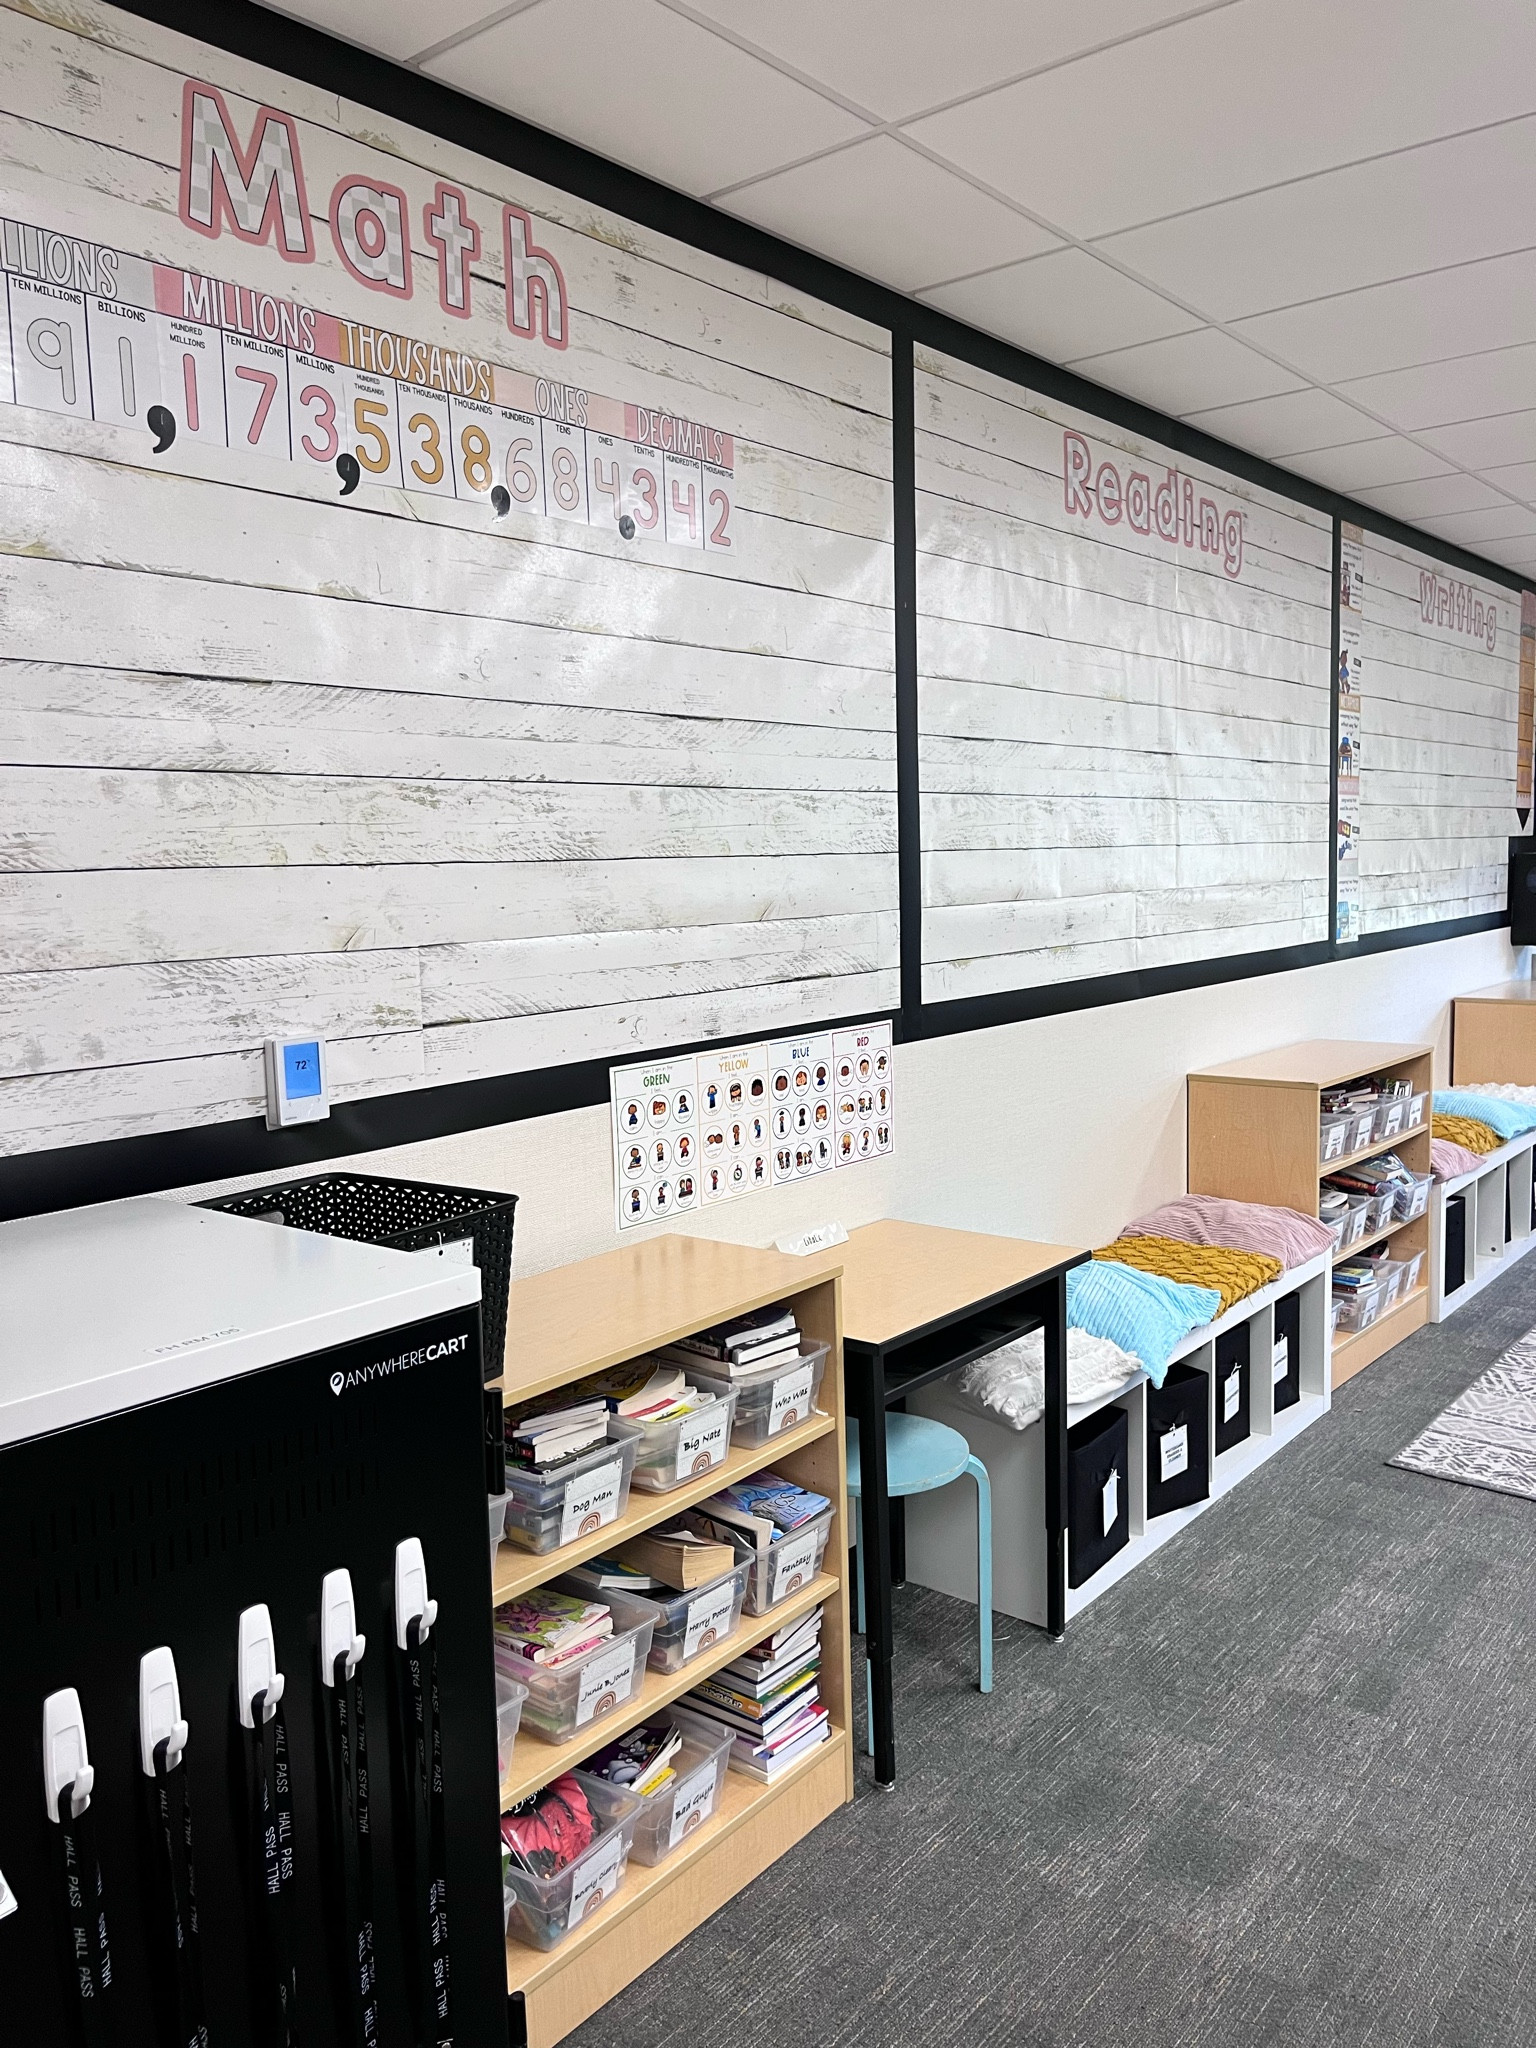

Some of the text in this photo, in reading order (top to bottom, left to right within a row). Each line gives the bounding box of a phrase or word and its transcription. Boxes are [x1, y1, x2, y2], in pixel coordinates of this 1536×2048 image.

[178, 79, 568, 350] Math
[12, 278, 82, 304] TEN MILLIONS
[98, 301, 146, 322] BILLIONS
[183, 272, 315, 354] MILLIONS
[169, 334, 205, 349] MILLIONS
[170, 321, 202, 336] HUNDRED
[225, 335, 284, 358] TEN MILLIONS
[296, 354, 335, 374] MILLIONS
[342, 321, 490, 402] THOUSANDS
[354, 383, 384, 396] THOUSANDS
[357, 374, 380, 385] HUNDRED
[399, 383, 447, 403] TEN THOUSANDS
[454, 397, 493, 415] THOUSANDS
[501, 410, 534, 425] HUNDREDS
[535, 378, 588, 428] ONES
[26, 318, 76, 405] 9
[235, 365, 278, 445] 7
[300, 384, 339, 461] 3
[354, 397, 391, 474] 5
[408, 413, 444, 485] 3
[461, 424, 493, 492] 8
[506, 438, 537, 503] 6
[551, 446, 580, 511] 8
[594, 457, 622, 521] 4
[632, 468, 659, 530] 3
[672, 479, 696, 539] 4
[708, 489, 732, 547] 2
[556, 424, 571, 435] TENS
[598, 436, 613, 446] ONES
[637, 406, 724, 465] DECIMALS
[633, 445, 655, 457] TENTHS
[666, 455, 699, 469] HUNDREDTHS
[1063, 431, 1243, 579] Reading
[1420, 571, 1497, 653] Writing
[792, 1047, 809, 1060] BLUE
[857, 1036, 869, 1047] RED
[643, 1073, 670, 1088] GREEN
[718, 1059, 749, 1073] YELLOW
[345, 1334, 469, 1389] ANYWHERECART
[775, 1396, 791, 1409] Who
[683, 1428, 721, 1451] Big Nate
[573, 1490, 613, 1513] Dog Man
[781, 1553, 811, 1576] Fantasy
[689, 1604, 731, 1633] Harry Potter
[410, 1659, 420, 1688] PASS
[581, 1682, 603, 1702] Junie
[610, 1667, 630, 1686] Jones
[338, 1699, 347, 1726] HALL
[357, 1722, 365, 1751] HALL
[275, 1724, 288, 1794] HALL PASS
[433, 1763, 442, 1793] PASS
[160, 1788, 169, 1819] HALL
[358, 1768, 370, 1834] HALL PASS
[675, 1782, 714, 1820] Bad Guys
[265, 1826, 277, 1858] PASS
[278, 1811, 293, 1880] HALL PASS
[64, 1835, 82, 1908] HALL PASS
[267, 1862, 280, 1895] HALL
[432, 1914, 441, 1947] HALL
[73, 1927, 94, 1998] HALL PASS
[101, 1950, 112, 1989] HALL
[360, 1963, 370, 1995] PASS
[434, 1958, 448, 2019] HALL PASS
[364, 2006, 375, 2038] HALL
